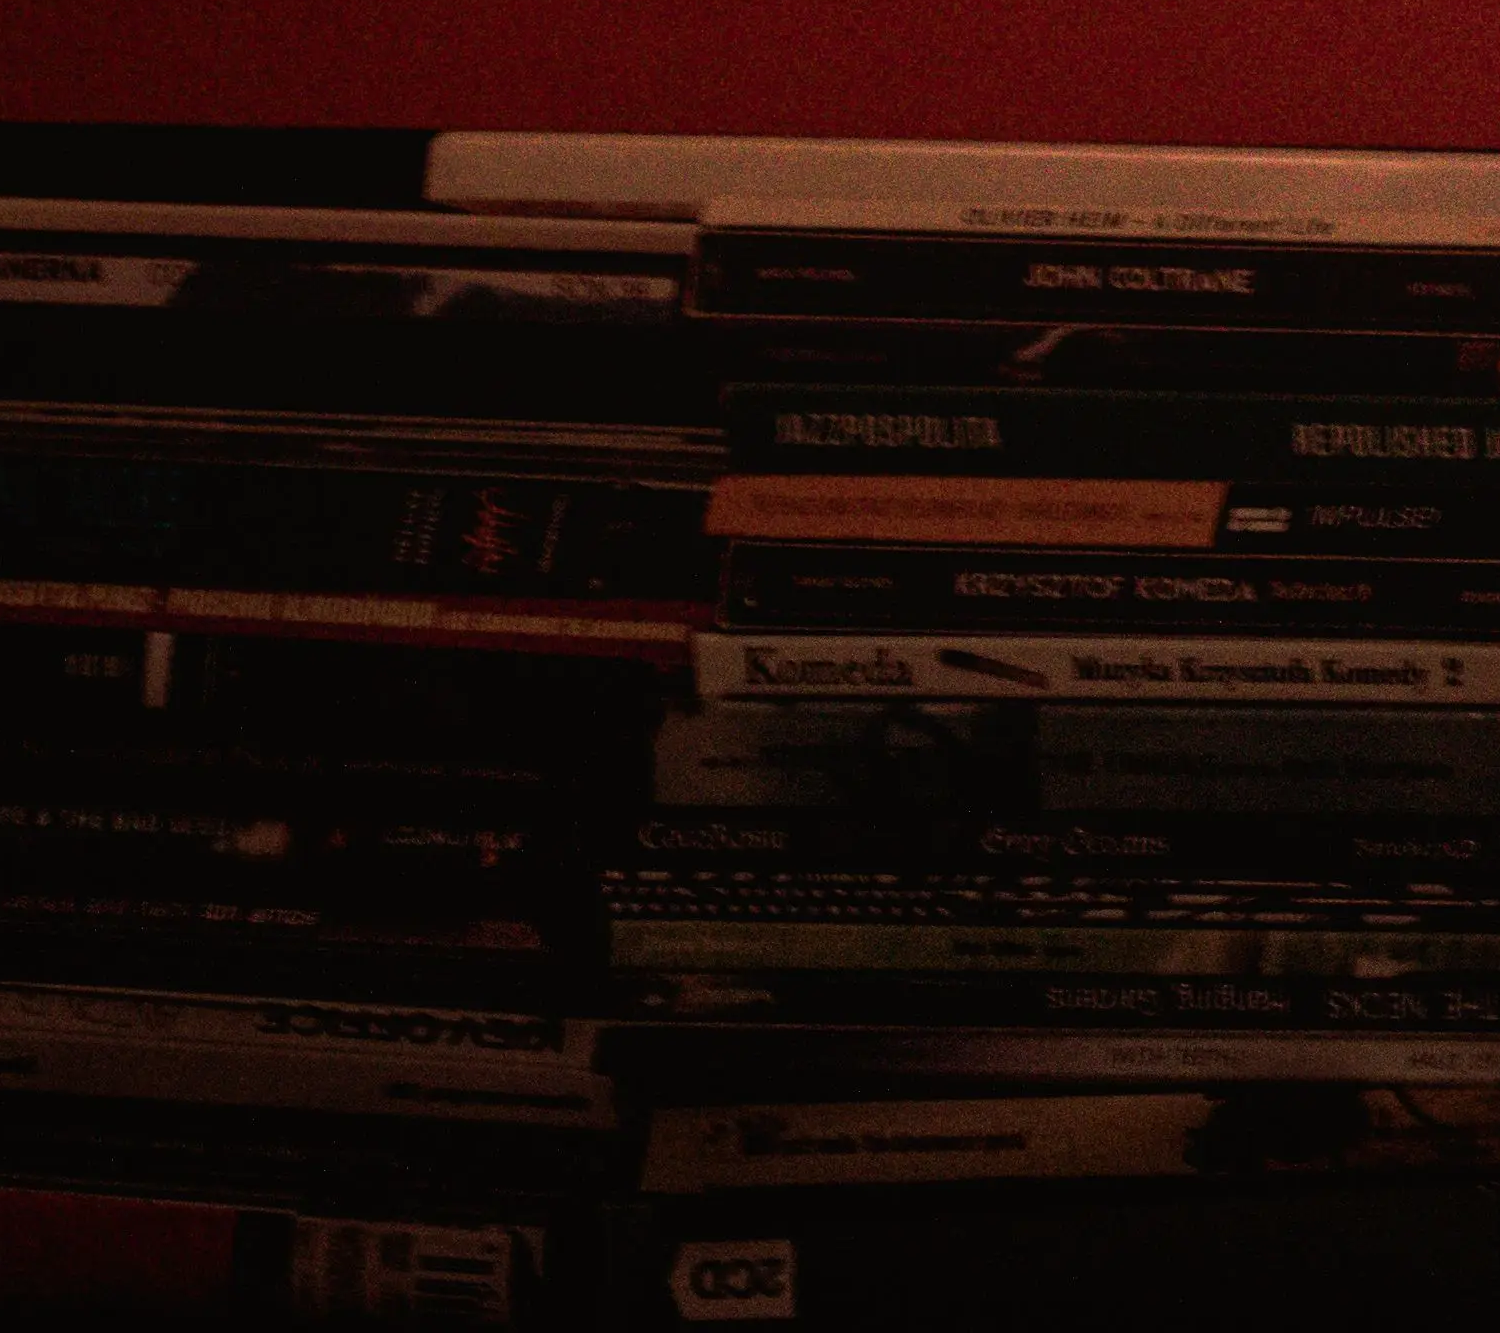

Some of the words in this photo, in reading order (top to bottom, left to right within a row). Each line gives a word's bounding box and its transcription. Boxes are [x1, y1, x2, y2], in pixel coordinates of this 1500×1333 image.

[1023, 261, 1102, 292] JOHN
[1107, 264, 1257, 297] COLTRANE
[773, 413, 1003, 451] JAZZPOSPOLITA
[1290, 421, 1477, 461] REPOLISHED
[952, 573, 1127, 602] KRZYSZTOF
[1133, 577, 1257, 604] KOMEDA
[741, 648, 915, 688] Komeda
[1071, 654, 1172, 687] Muzyka
[1322, 658, 1430, 690] Komedy
[1442, 659, 1464, 688] 2
[1044, 980, 1165, 1016] Gardens
[1172, 984, 1293, 1017] Hanging
[1322, 989, 1430, 1022] NECKS
[1443, 992, 1500, 1022] THE
[691, 1255, 786, 1299] 2CD
